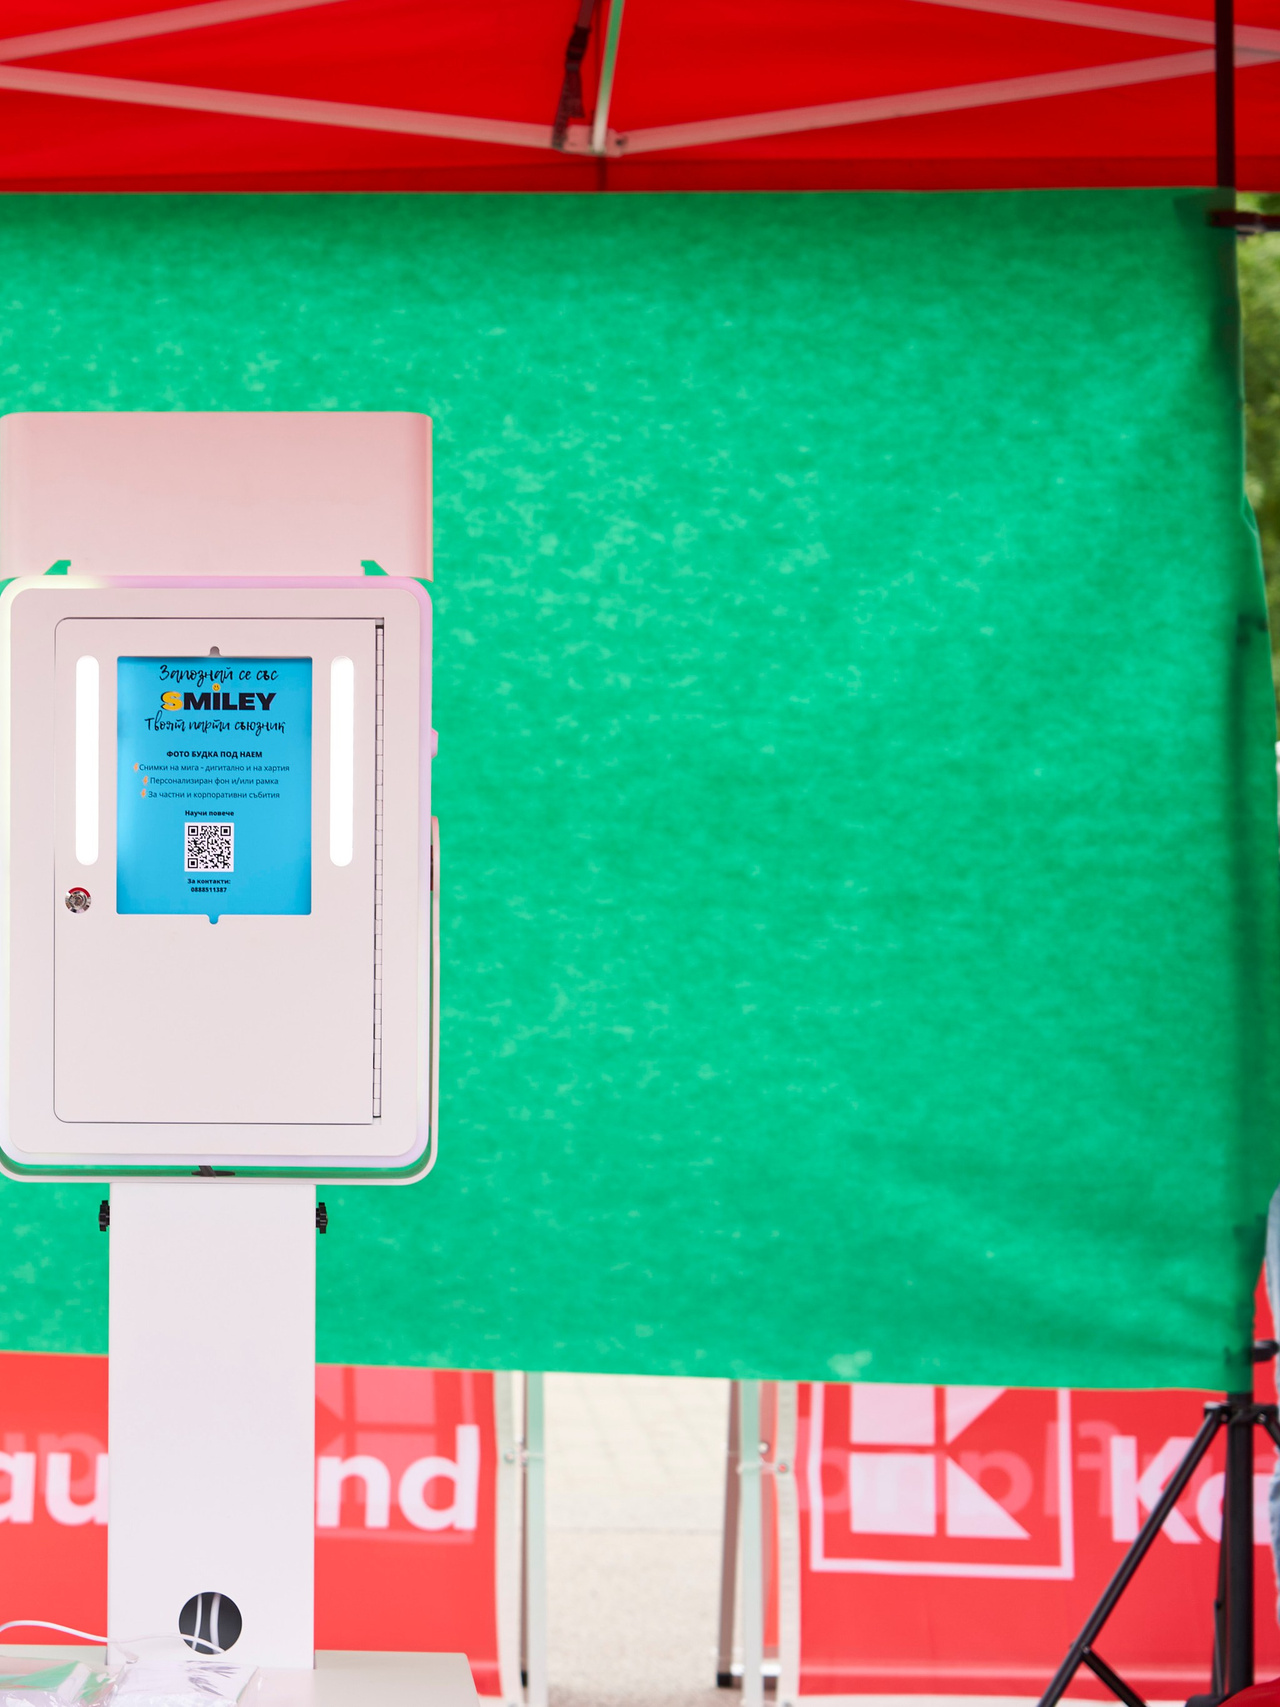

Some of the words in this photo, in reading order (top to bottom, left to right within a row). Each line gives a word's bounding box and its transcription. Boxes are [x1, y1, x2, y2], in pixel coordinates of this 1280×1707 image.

[159, 664, 234, 688] Запознай
[238, 669, 252, 682] се
[256, 669, 279, 682] със
[144, 710, 186, 732] Твоят
[189, 718, 231, 734] парти
[234, 719, 286, 737] съюзник
[166, 750, 190, 758] ФОТО
[192, 751, 218, 759] БУДКА
[220, 751, 238, 759] ПОД
[205, 765, 244, 773] дигитално
[264, 765, 290, 773] хартия
[150, 777, 213, 785] Персонализиран
[215, 777, 230, 785] фон
[231, 777, 254, 785] и/или
[256, 778, 279, 786] рамка
[194, 792, 247, 800] корпоративни
[249, 791, 280, 799] събития
